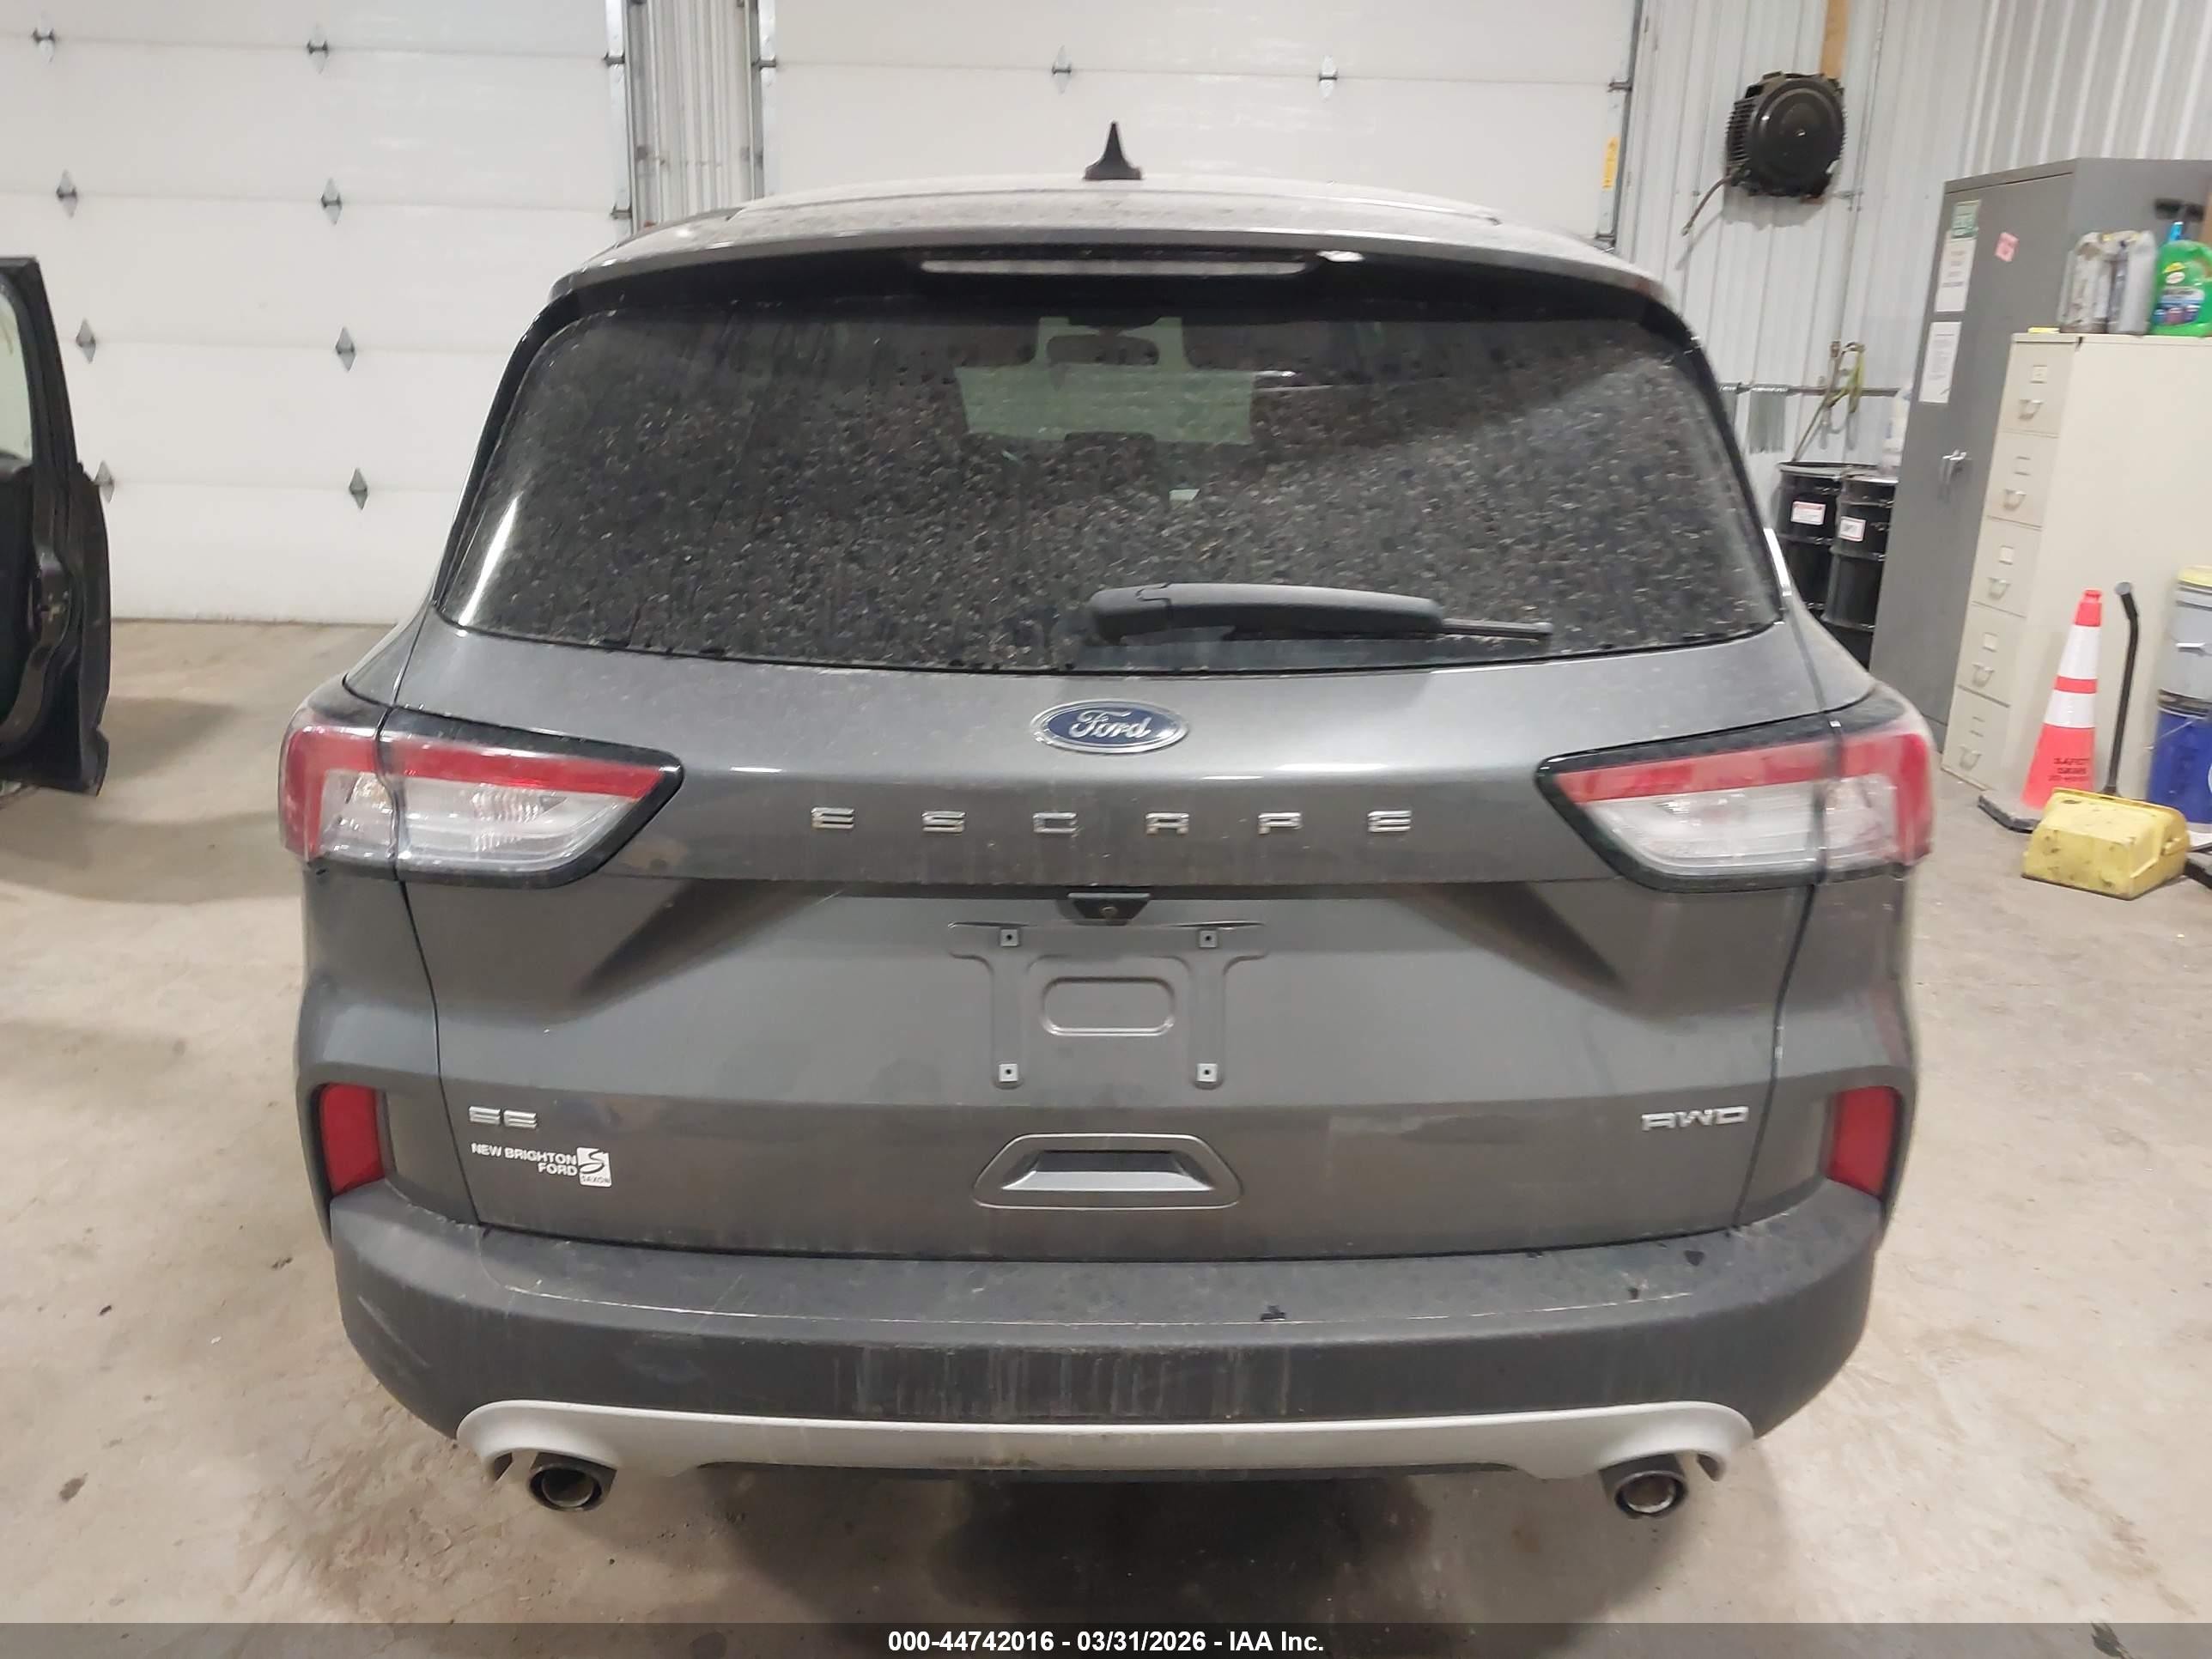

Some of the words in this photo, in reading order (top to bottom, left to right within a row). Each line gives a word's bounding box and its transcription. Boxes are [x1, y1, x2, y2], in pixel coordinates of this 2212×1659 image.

[1069, 709, 1152, 738] Ford
[811, 807, 1412, 835] ESCAPE
[469, 1105, 538, 1129] SE
[1641, 1105, 1749, 1131] AWD
[471, 1143, 502, 1158] NEW
[504, 1146, 578, 1166] BRIGHTON
[538, 1162, 579, 1176] FORD
